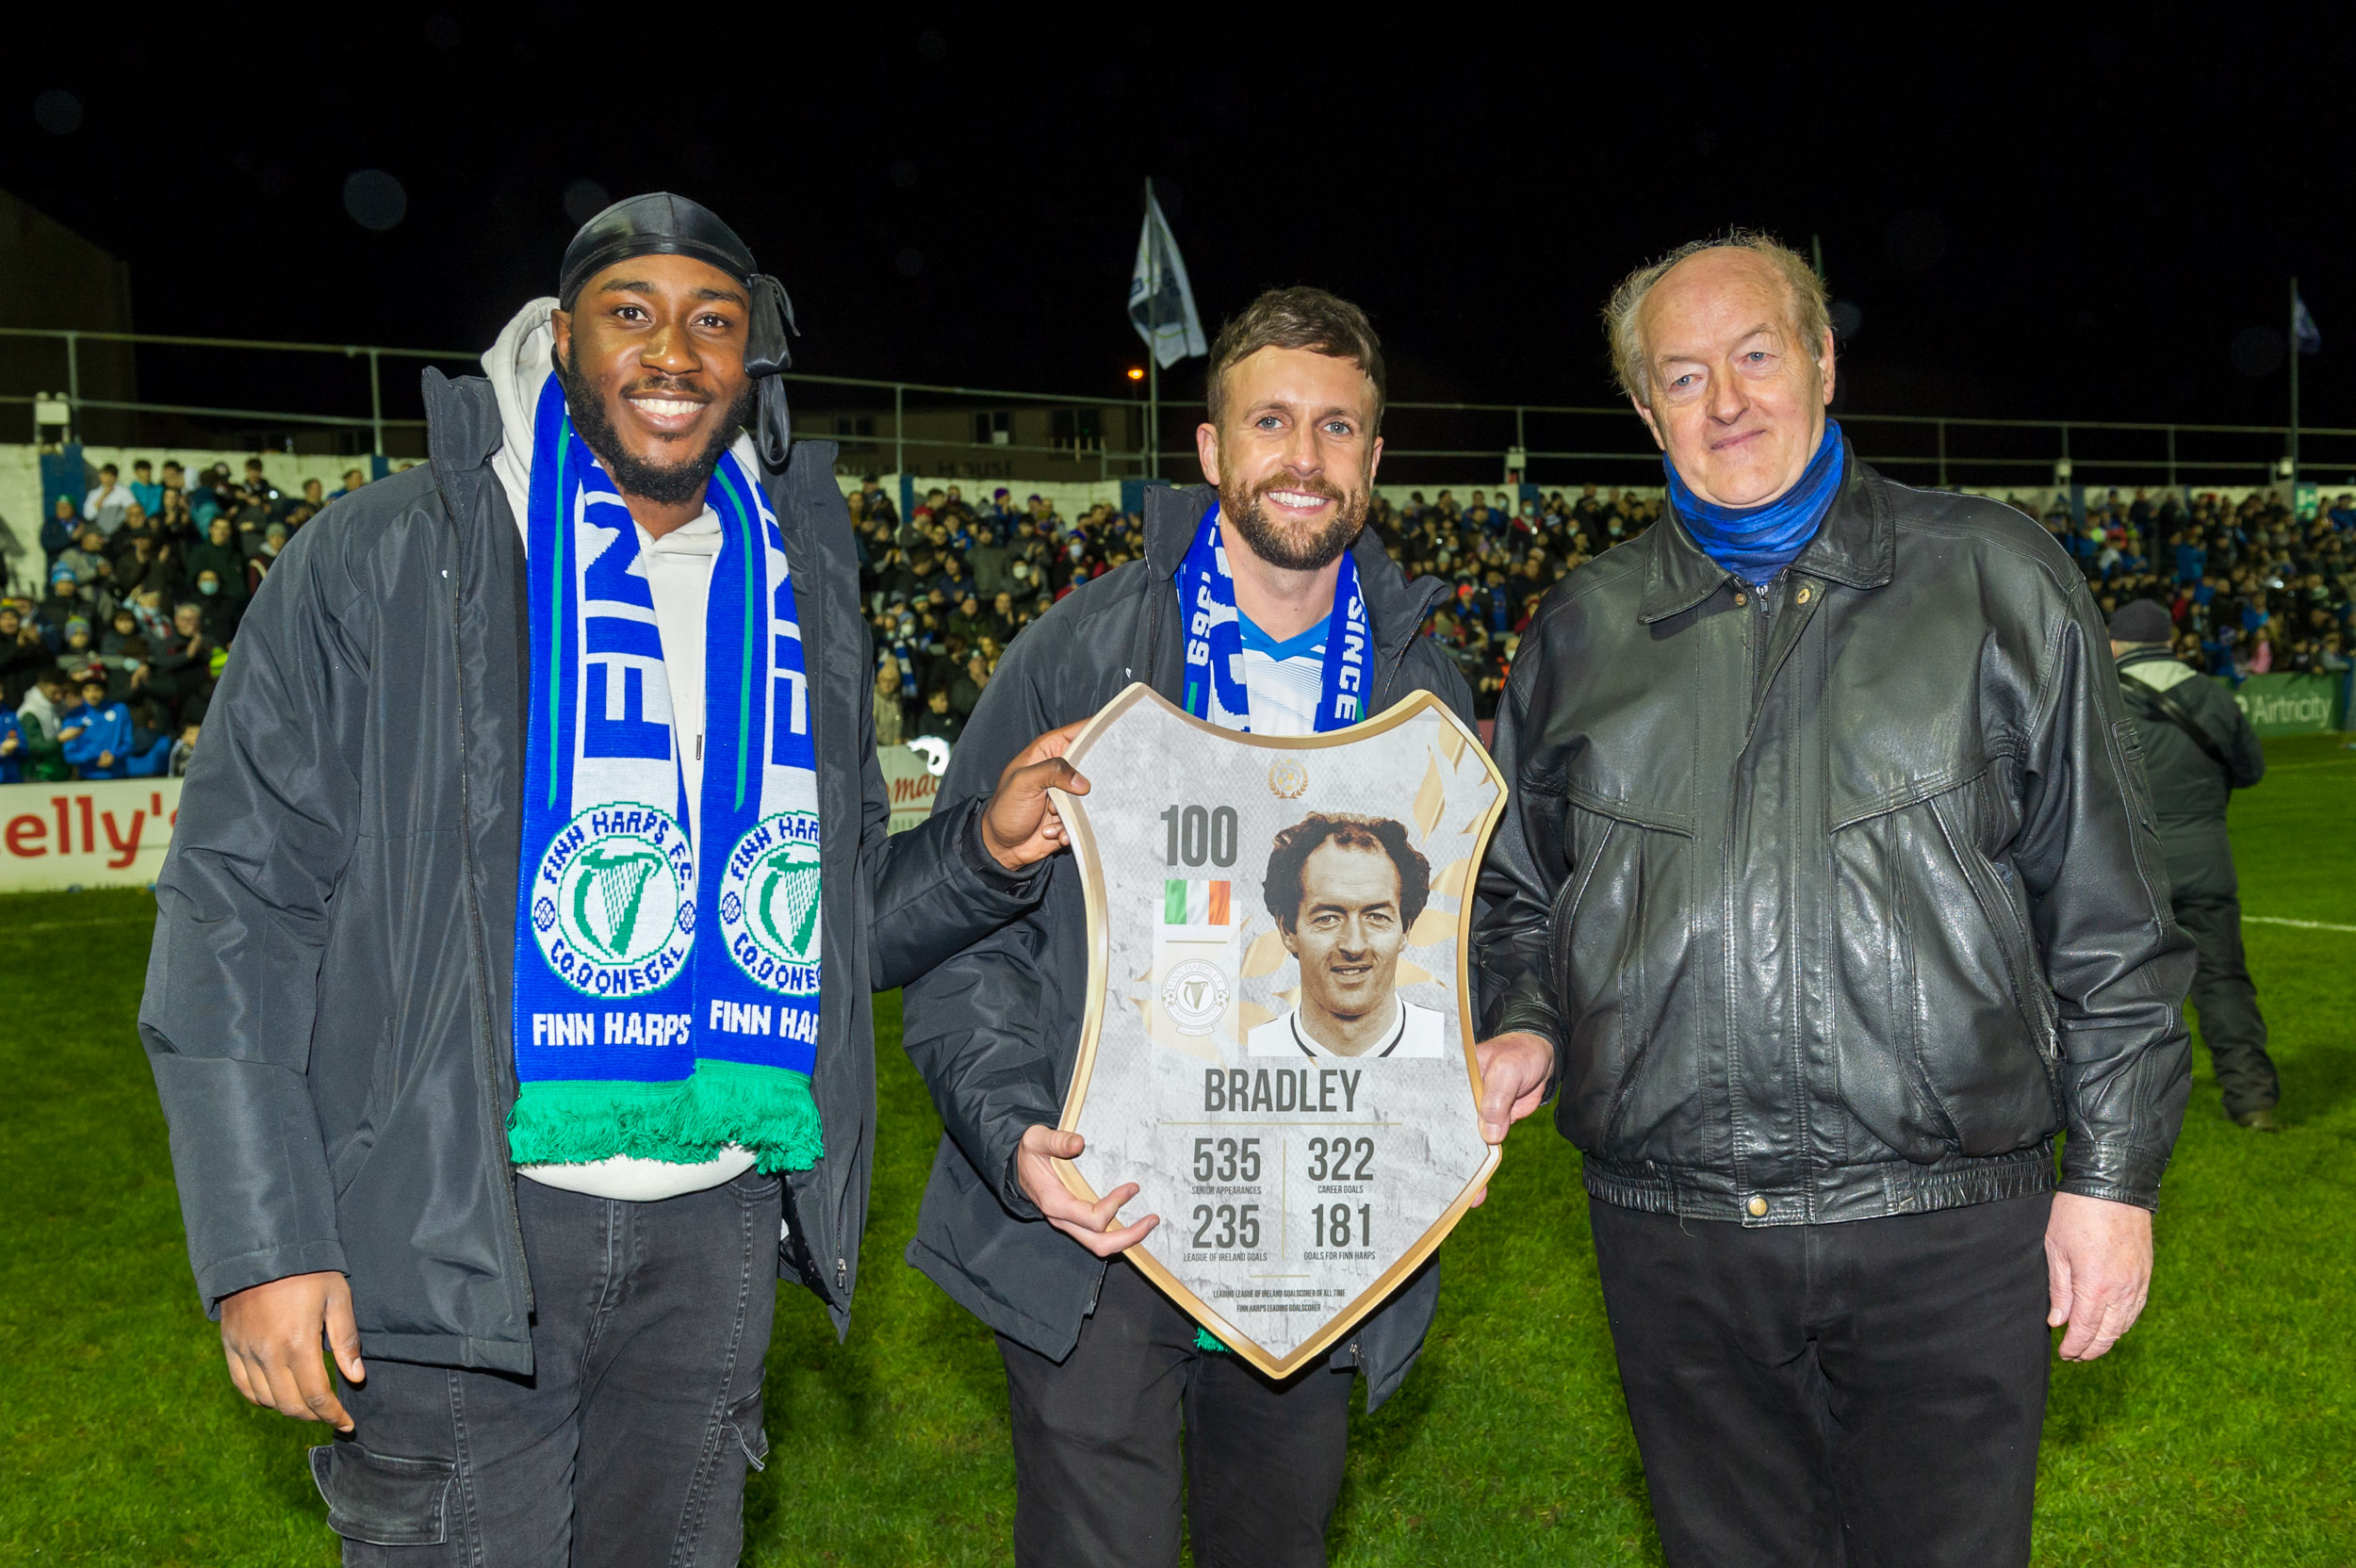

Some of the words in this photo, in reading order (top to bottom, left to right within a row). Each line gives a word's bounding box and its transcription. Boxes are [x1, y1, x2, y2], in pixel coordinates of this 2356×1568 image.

[1334, 596, 1366, 722] SINCE
[0, 792, 179, 871] elly'
[543, 825, 585, 885] FINN
[592, 811, 669, 844] HARPS
[730, 826, 773, 881] FINN
[1160, 804, 1238, 868] 100
[532, 1013, 595, 1046] FINN
[603, 1012, 692, 1046] HARPS
[709, 999, 772, 1036] FINN
[1204, 1069, 1362, 1112] BRADLEY
[1193, 1137, 1261, 1183] 535
[1307, 1136, 1375, 1182] 322
[1191, 1185, 1215, 1195] SENIOR
[1216, 1185, 1262, 1195] APPEARANCES
[1317, 1184, 1343, 1194] CAREER
[1343, 1184, 1364, 1194] GOALS
[1192, 1204, 1260, 1249] 235
[1311, 1203, 1370, 1248] 181
[1184, 1252, 1208, 1262] LEAGUE
[1209, 1252, 1218, 1262] OF
[1219, 1252, 1246, 1262] IRELAND
[1247, 1252, 1268, 1262] GOALS
[1303, 1251, 1325, 1261] GOALS
[1325, 1251, 1338, 1261] FOR
[1338, 1251, 1353, 1261] FINN
[1354, 1250, 1376, 1260] HARPS
[1213, 1289, 1235, 1298] LEADING
[1235, 1289, 1253, 1298] LEAGUE
[1254, 1289, 1261, 1298] OF
[1261, 1289, 1283, 1298] IRELAND
[1284, 1289, 1316, 1298] GOALSCORER
[1316, 1289, 1322, 1298] OF
[1323, 1288, 1333, 1298] ALL
[1333, 1288, 1346, 1298] TIME
[1236, 1304, 1249, 1313] FINN
[1249, 1304, 1267, 1313] HARPS
[1267, 1303, 1288, 1313] LEADING
[1288, 1303, 1321, 1312] GOALSCORER
